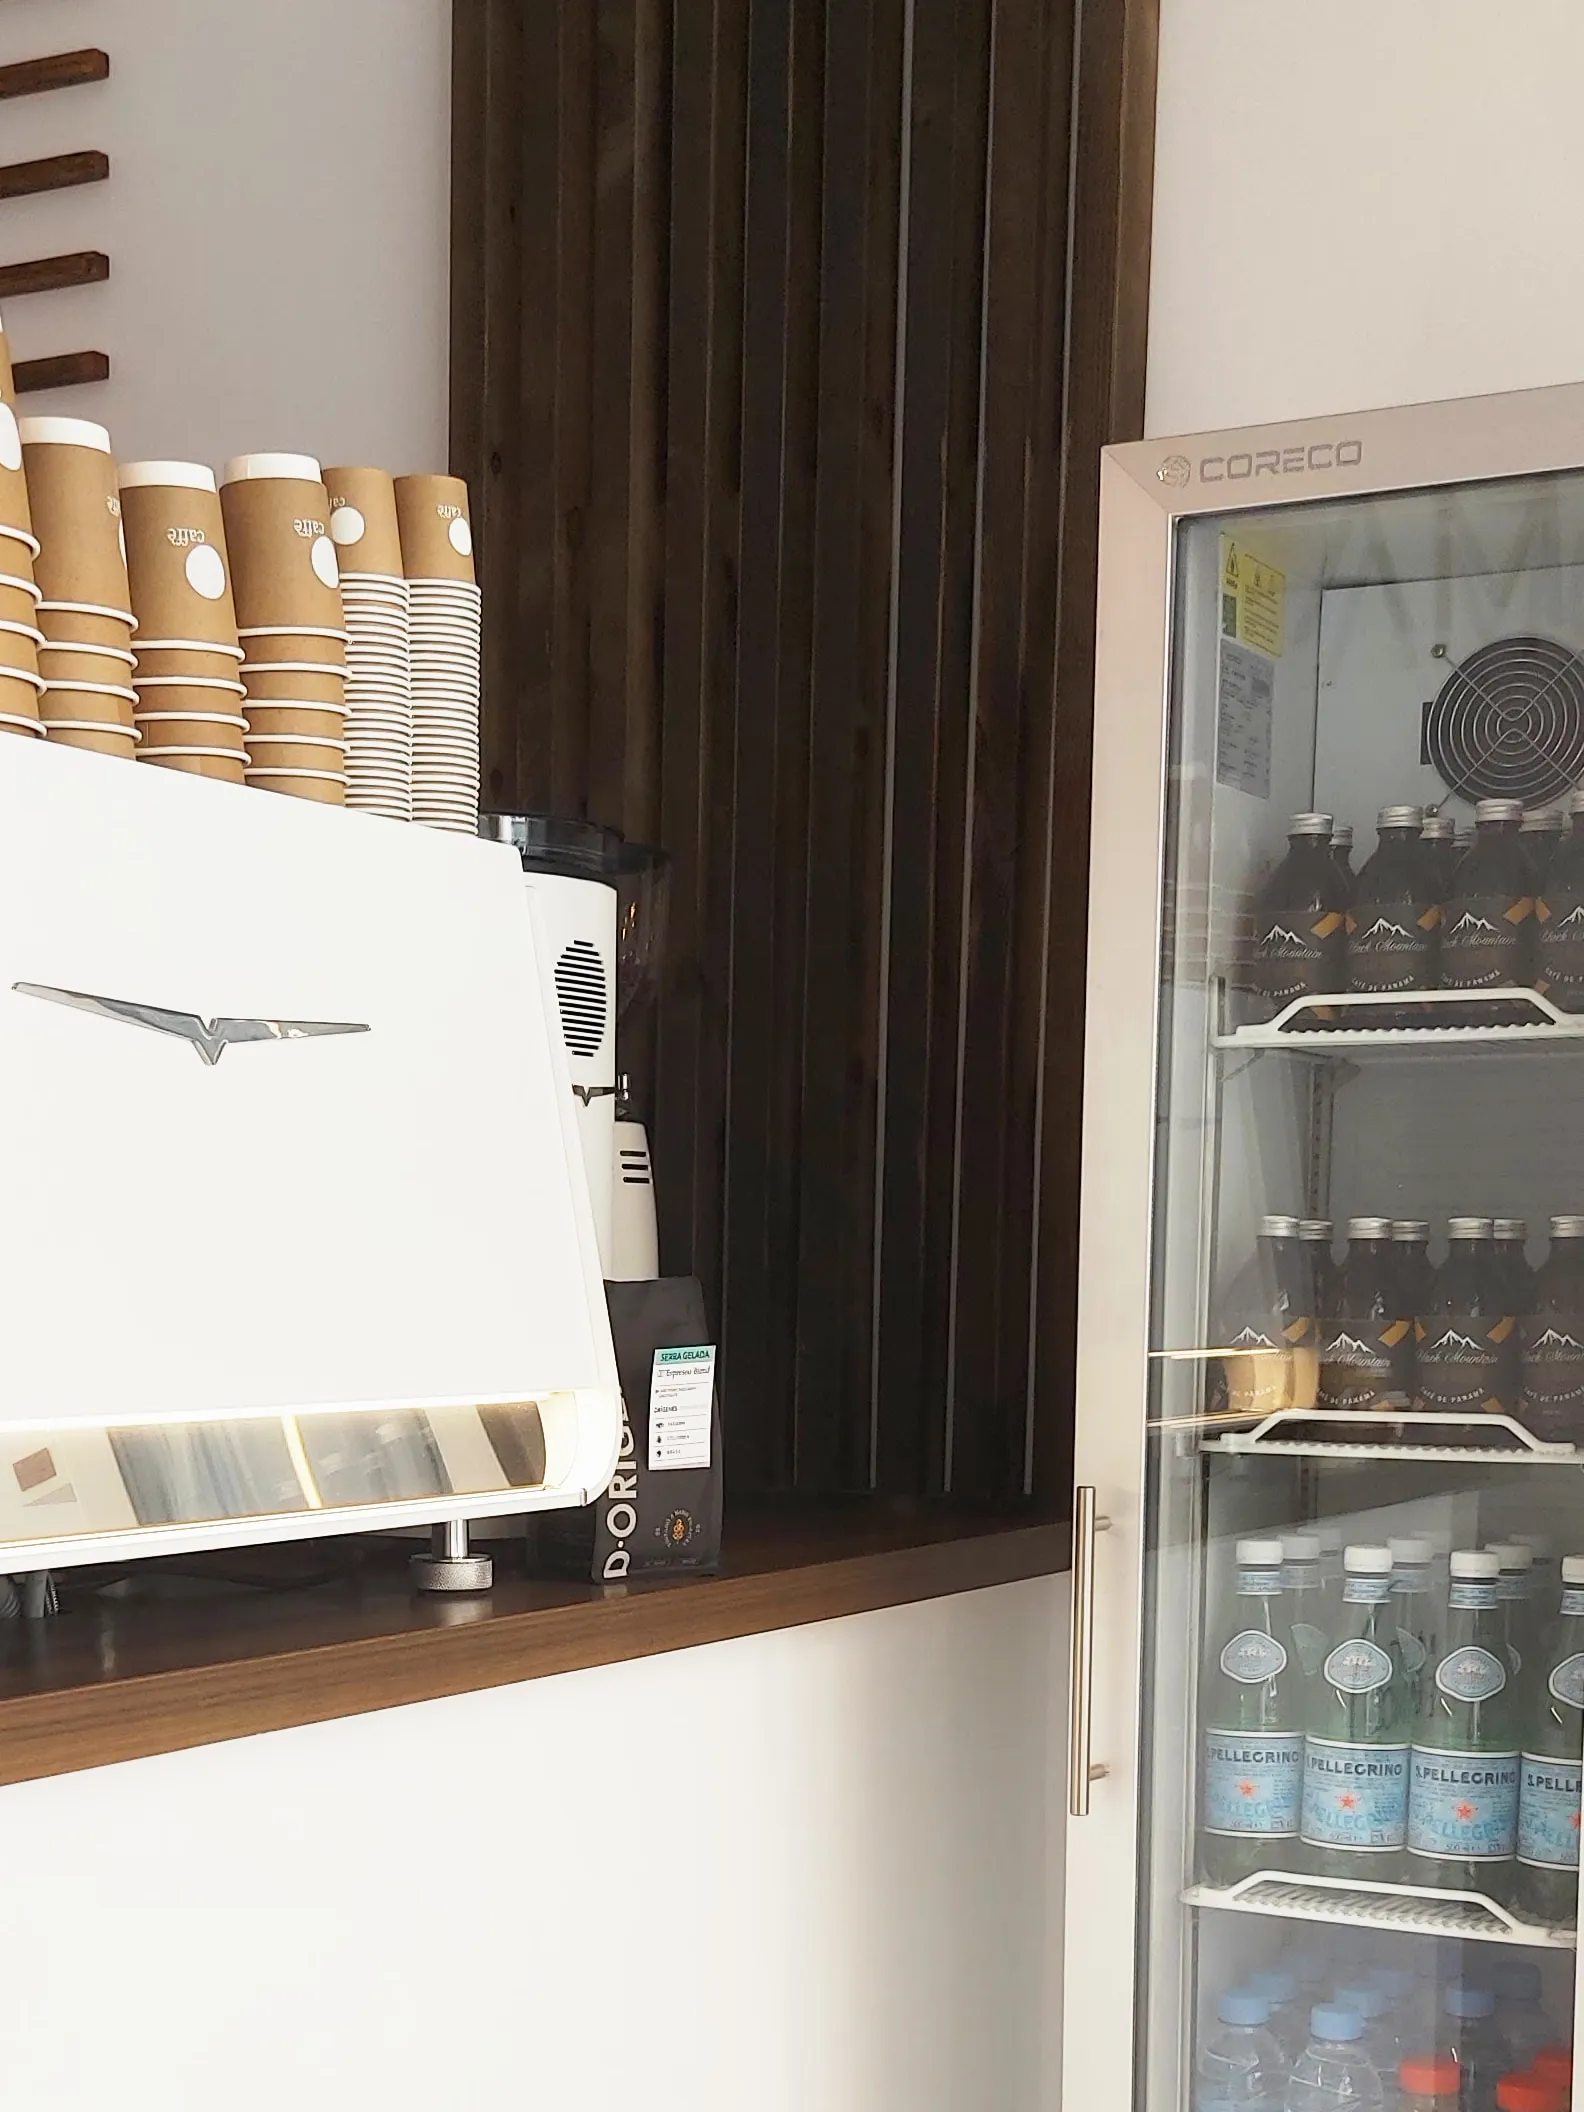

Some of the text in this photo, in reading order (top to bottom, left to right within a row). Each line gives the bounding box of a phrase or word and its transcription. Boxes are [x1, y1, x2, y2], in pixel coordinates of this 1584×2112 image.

[1199, 440, 1363, 484] CORECO
[166, 527, 206, 547] caffè
[293, 518, 325, 538] caffè
[683, 1350, 710, 1361] GELADA
